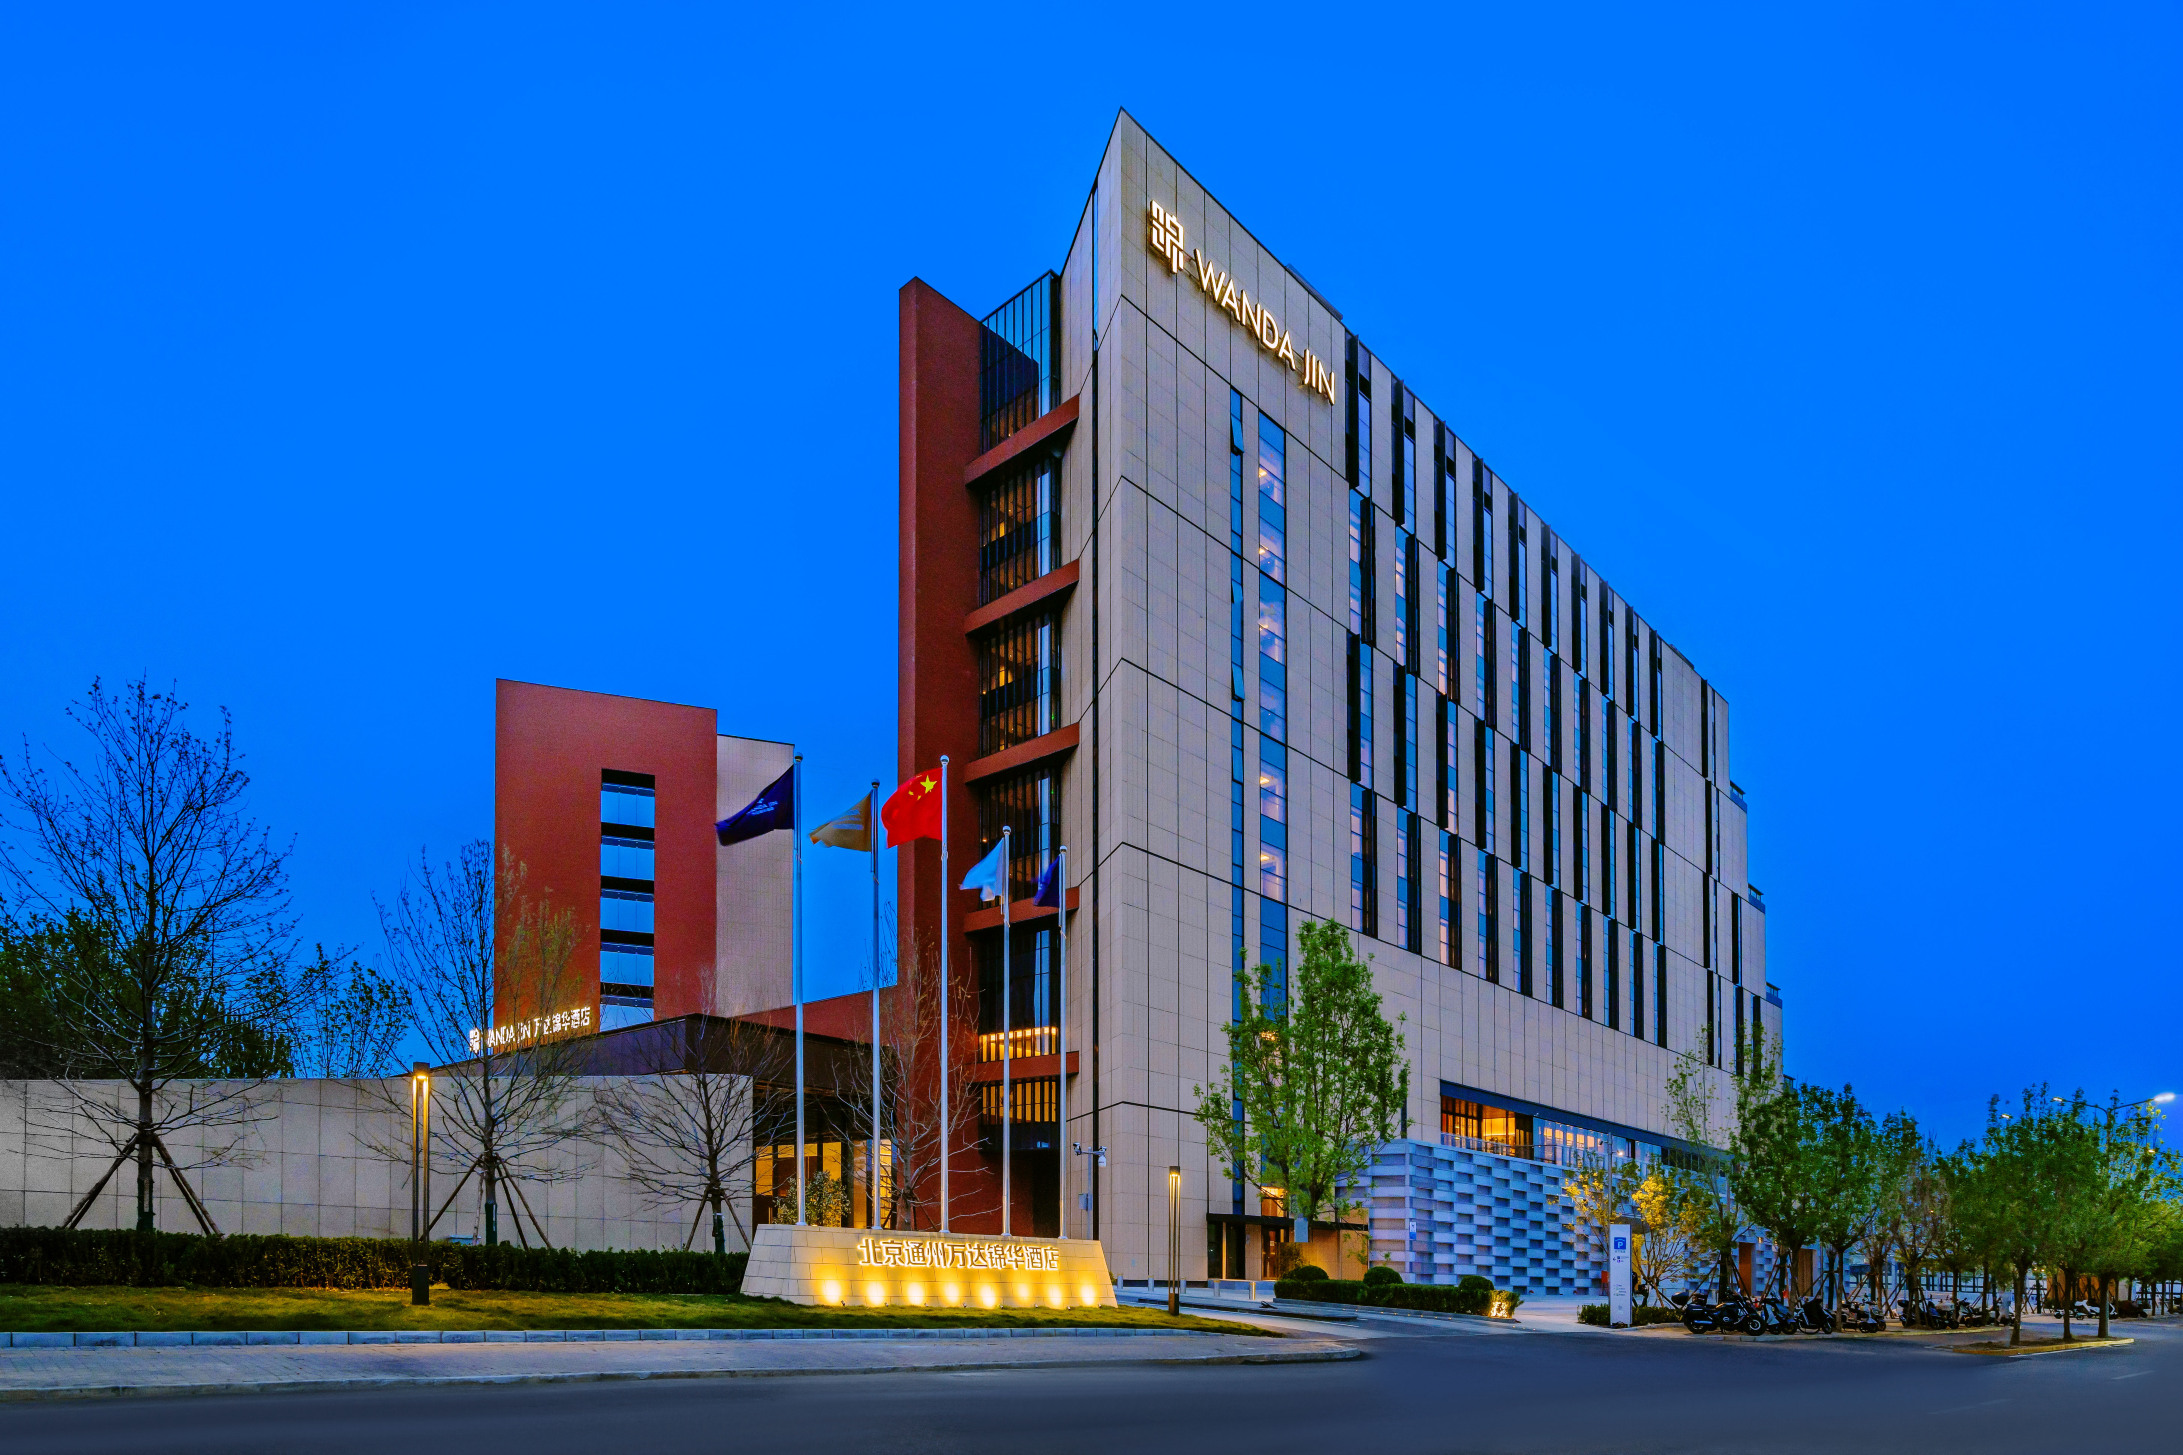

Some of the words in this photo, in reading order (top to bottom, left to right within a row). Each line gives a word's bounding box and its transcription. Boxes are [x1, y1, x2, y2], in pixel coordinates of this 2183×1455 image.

[1193, 248, 1297, 371] WANDA
[1303, 348, 1335, 406] JIN
[858, 1238, 1060, 1270] 北京通州万达锦华酒店
